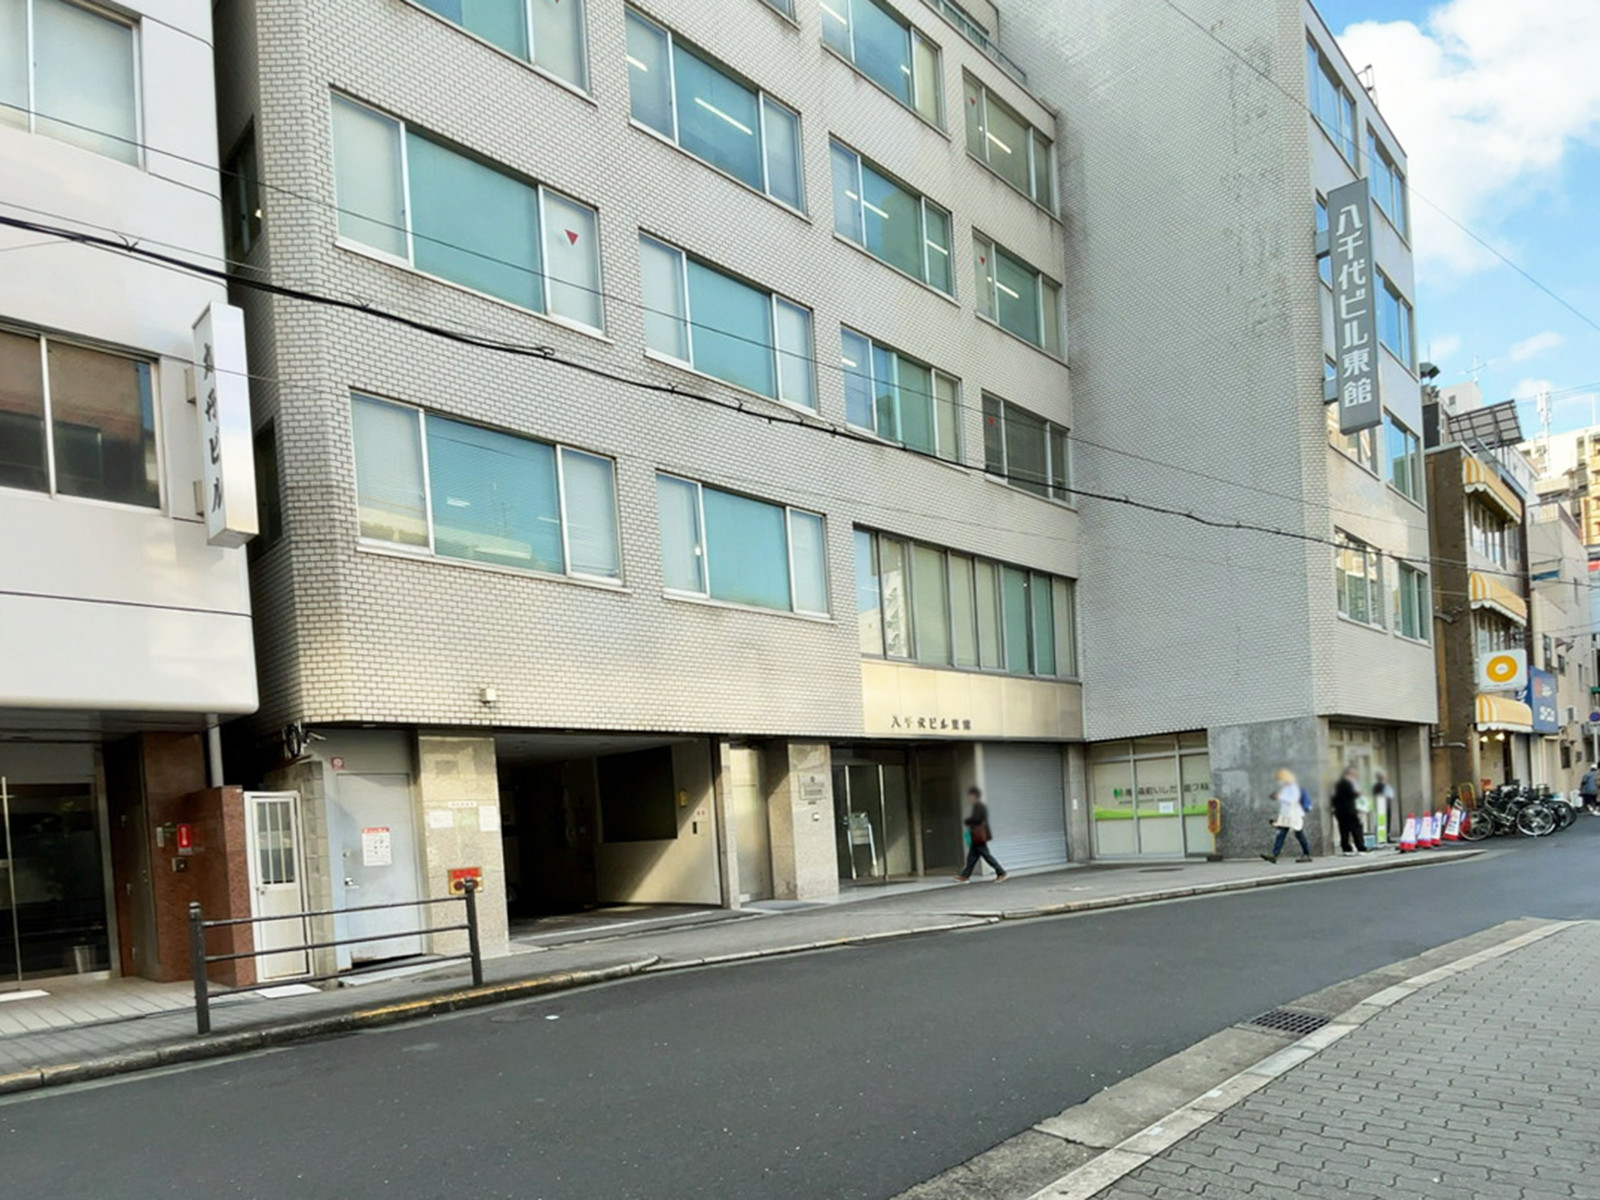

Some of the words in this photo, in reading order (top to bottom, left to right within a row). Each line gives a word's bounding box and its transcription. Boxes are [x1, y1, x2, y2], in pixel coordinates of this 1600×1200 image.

[1335, 204, 1372, 408] 八千代ビル東館
